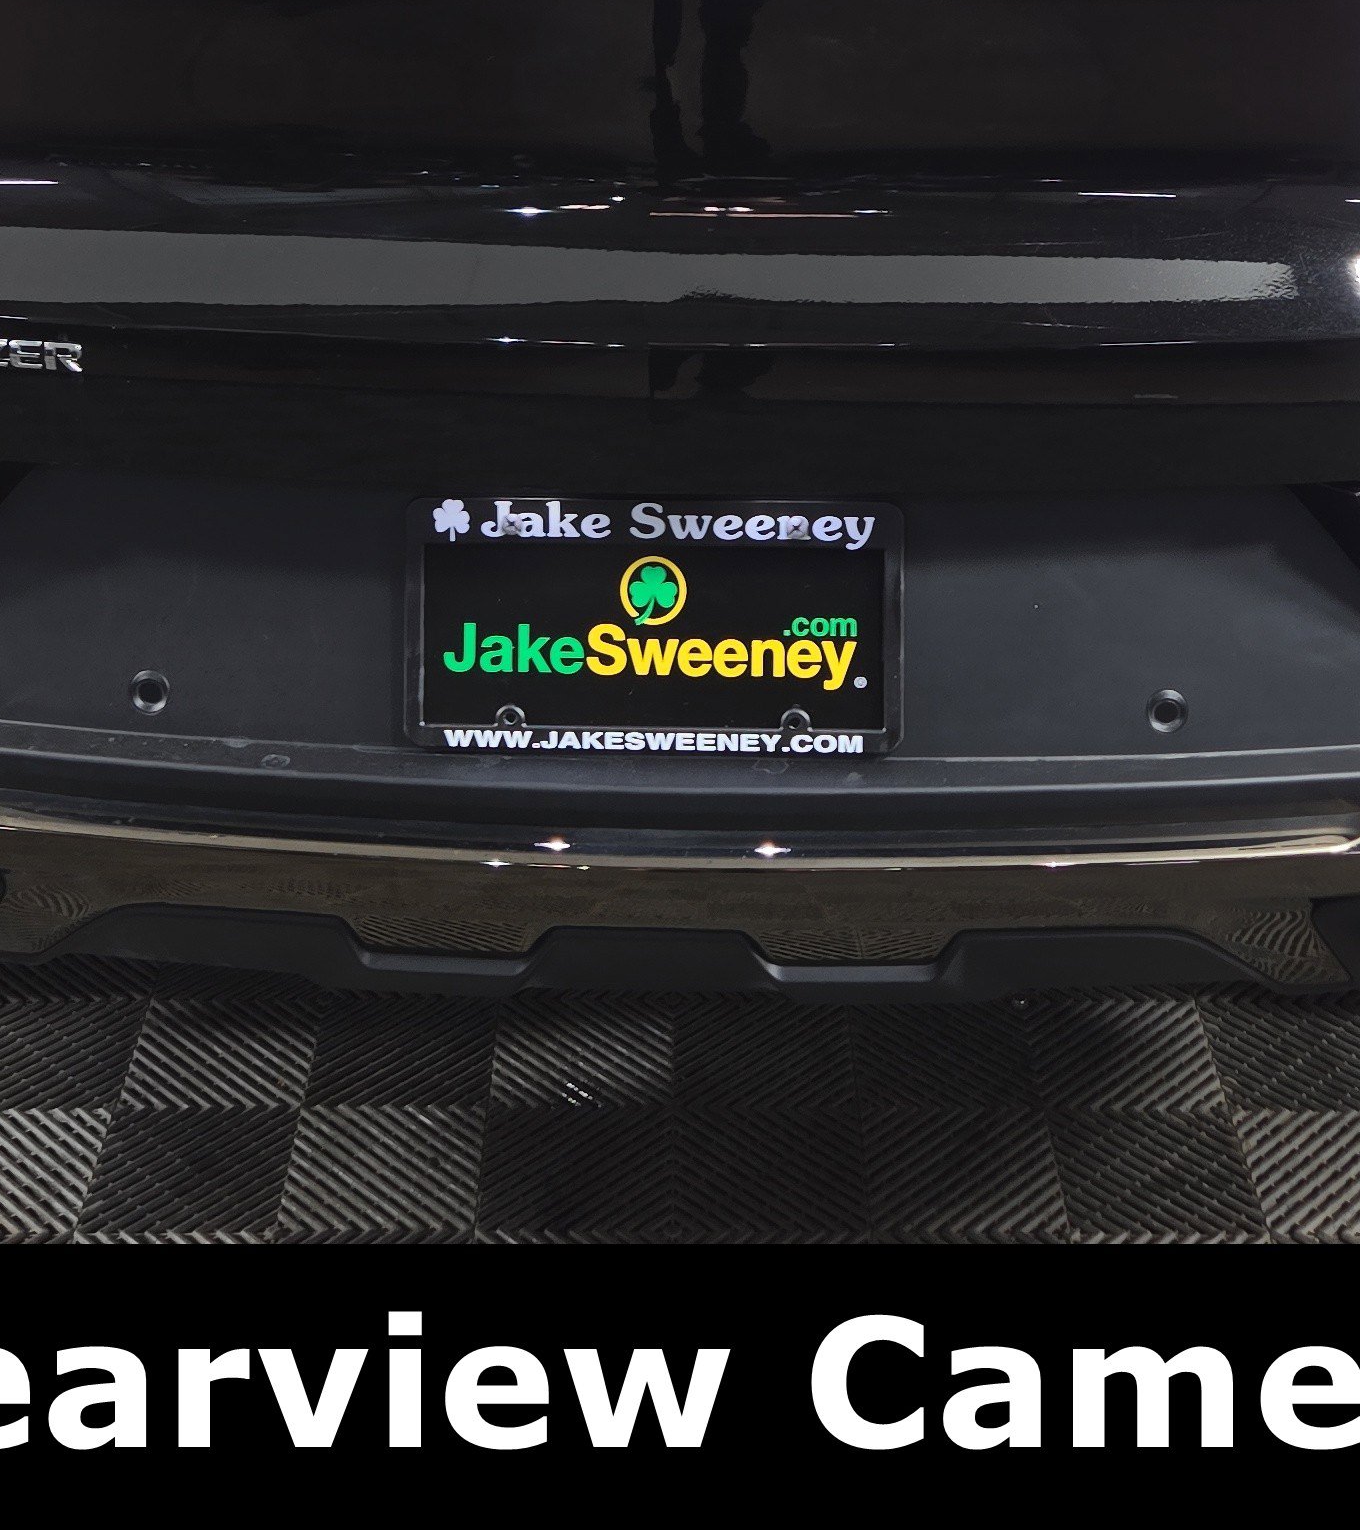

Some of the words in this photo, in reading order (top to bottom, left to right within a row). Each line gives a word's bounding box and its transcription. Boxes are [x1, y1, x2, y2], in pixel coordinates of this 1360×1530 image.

[481, 500, 611, 538] Jake
[630, 502, 875, 550] Sweeney
[783, 617, 858, 637] .com
[444, 729, 865, 754] WWW.JAKESWEENEY.COM
